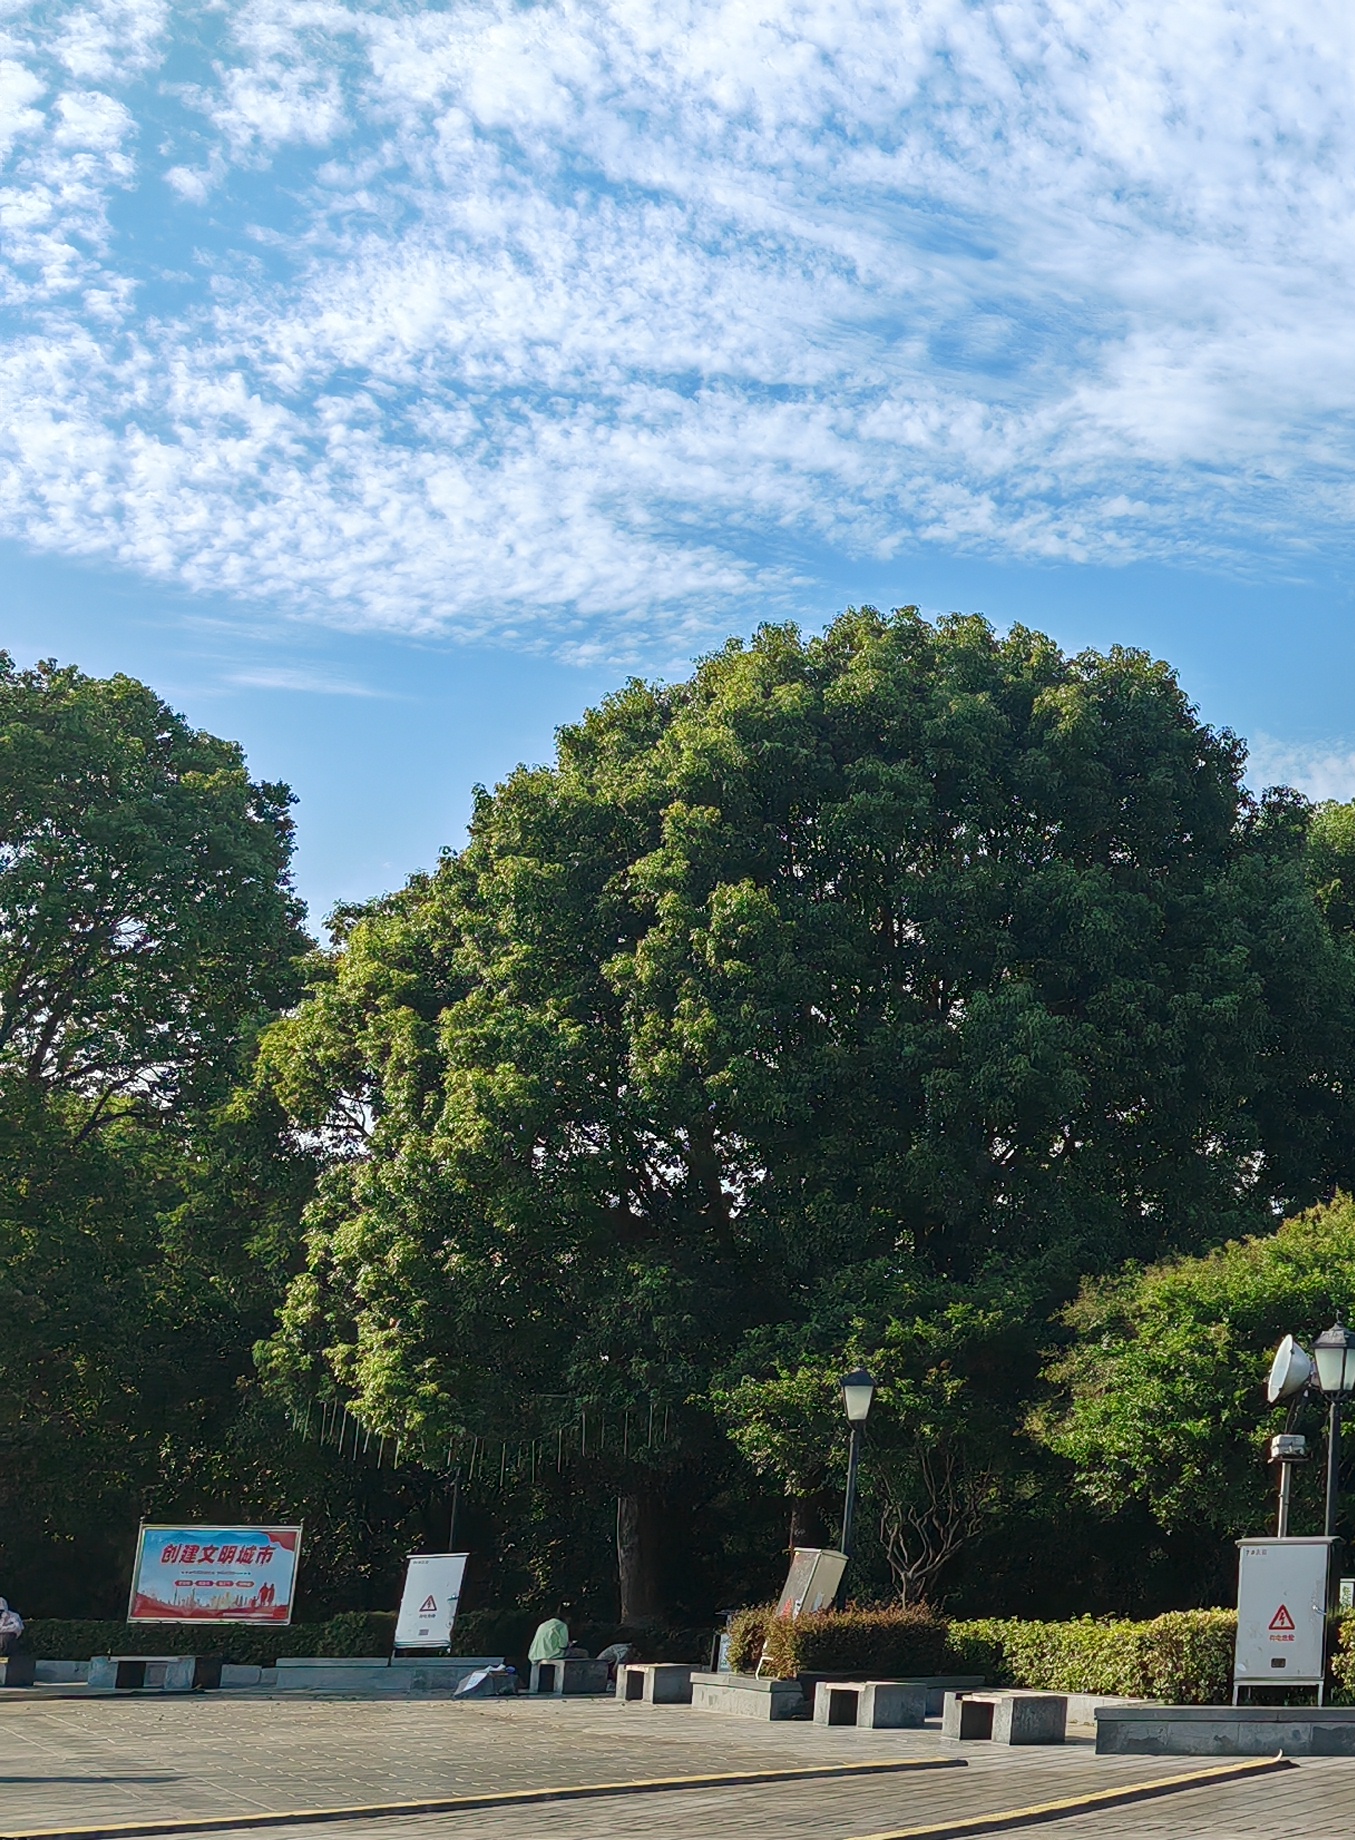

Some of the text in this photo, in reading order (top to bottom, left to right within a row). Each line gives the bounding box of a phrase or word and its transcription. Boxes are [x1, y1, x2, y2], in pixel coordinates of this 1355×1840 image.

[160, 1543, 277, 1566] 创建文明城市
